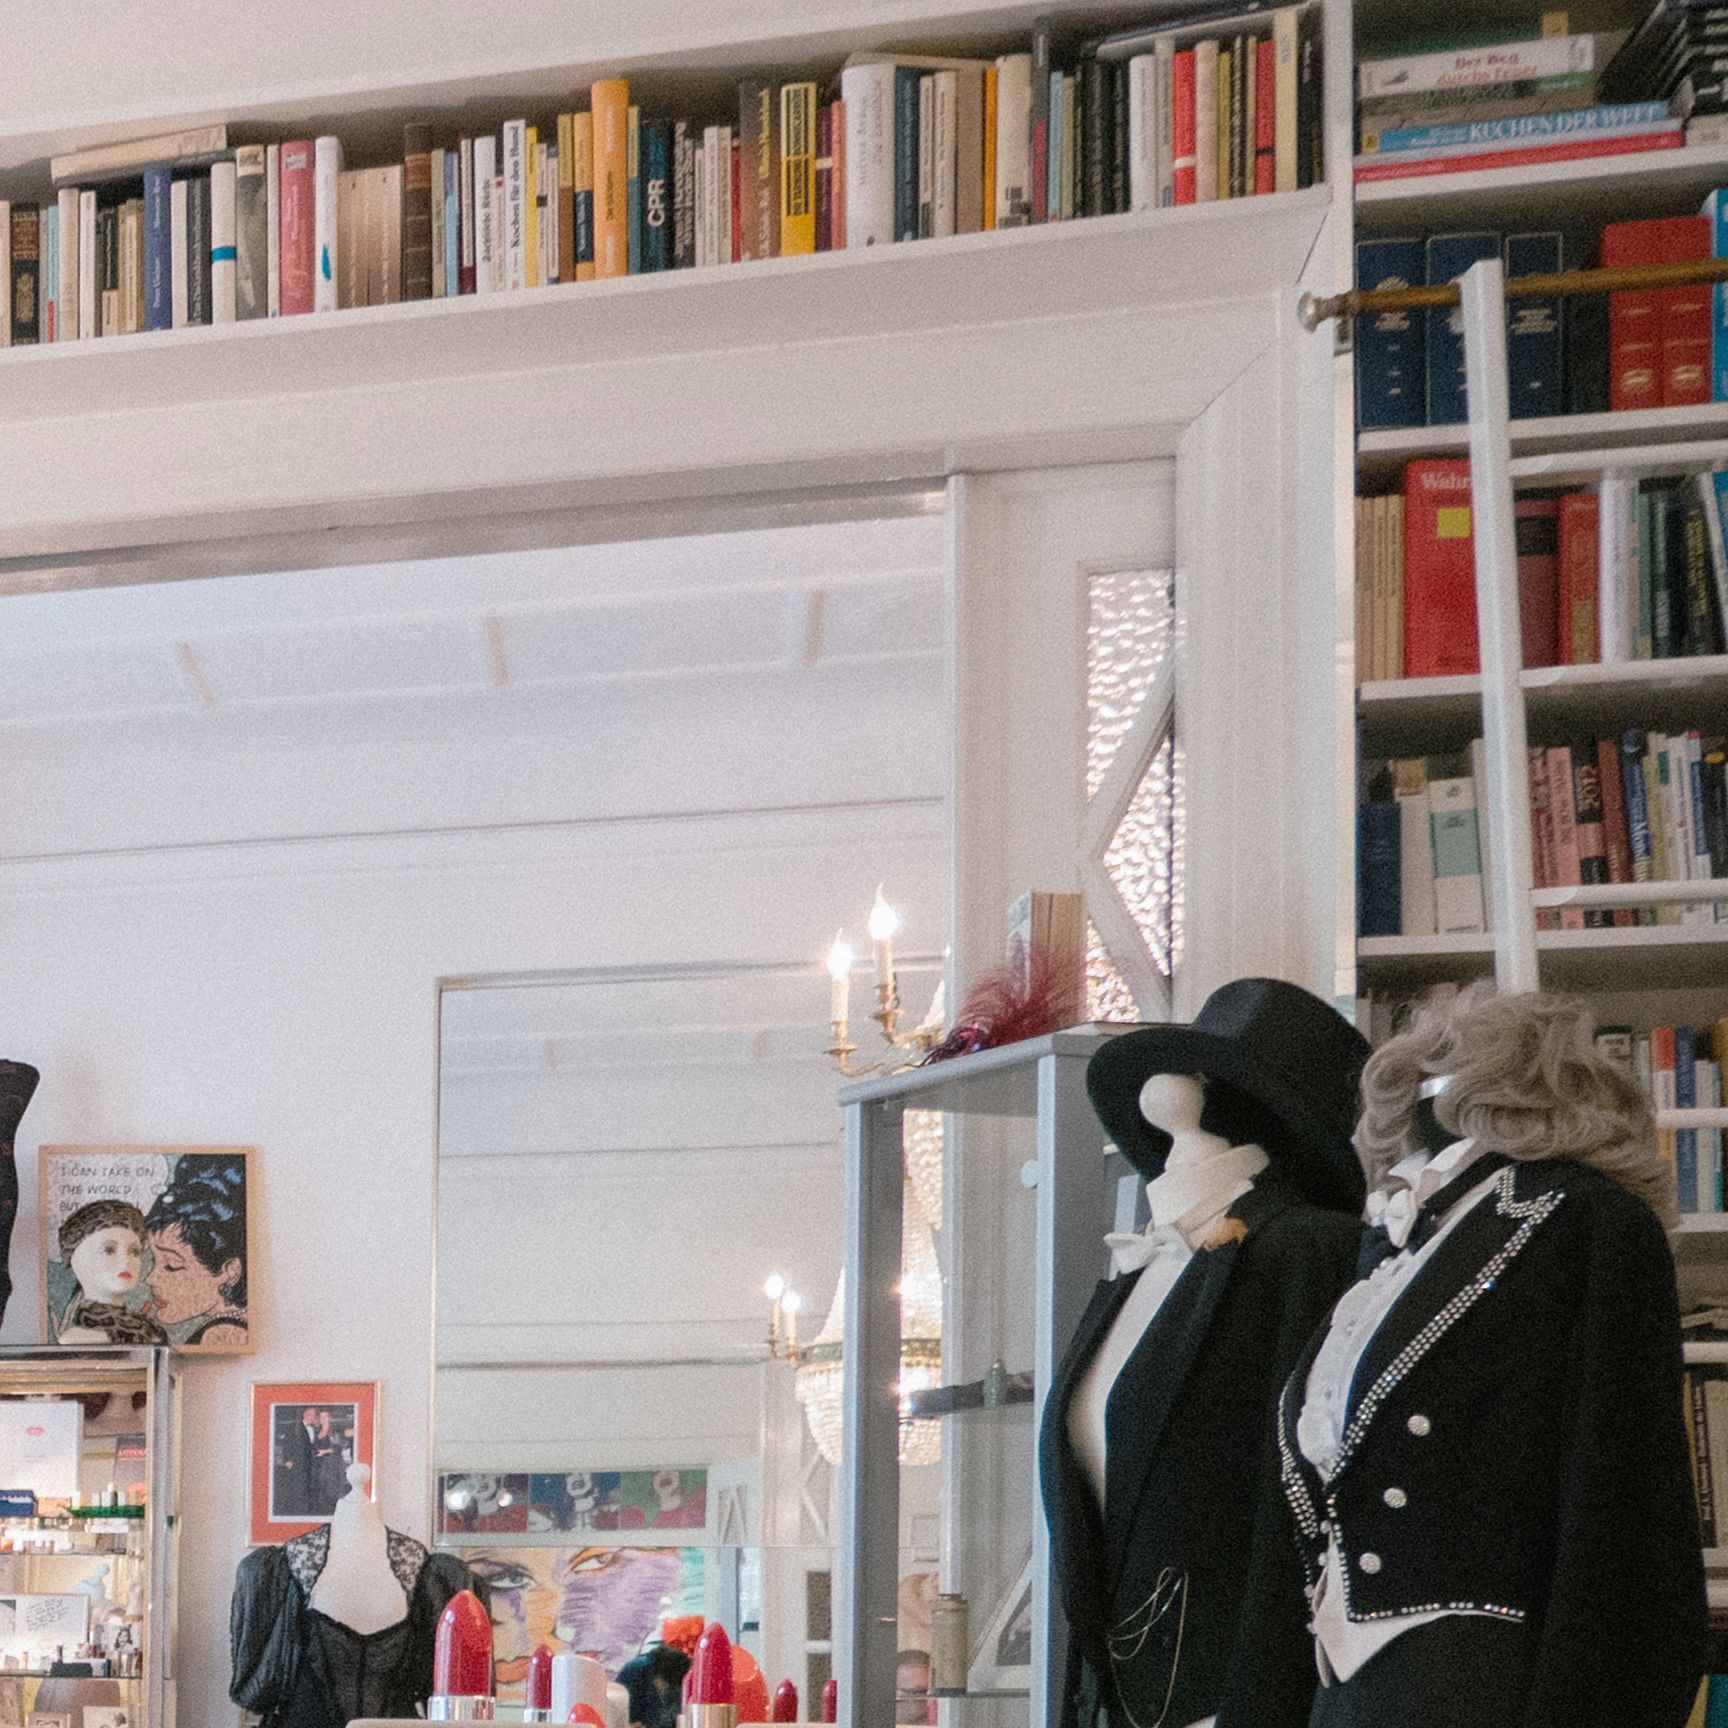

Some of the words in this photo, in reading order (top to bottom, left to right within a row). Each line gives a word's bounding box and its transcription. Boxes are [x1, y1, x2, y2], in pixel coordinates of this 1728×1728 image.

[1557, 112, 1598, 133] DER
[507, 124, 521, 158] Hund
[508, 162, 520, 182] den
[647, 179, 666, 227] CPR
[508, 205, 522, 248] Kochen
[1581, 764, 1600, 809] 2012
[70, 1165, 97, 1177] CAN
[101, 1166, 130, 1177] TAKE
[136, 1167, 155, 1177] ON
[60, 1185, 83, 1195] THE
[87, 1186, 132, 1195] WORLD
